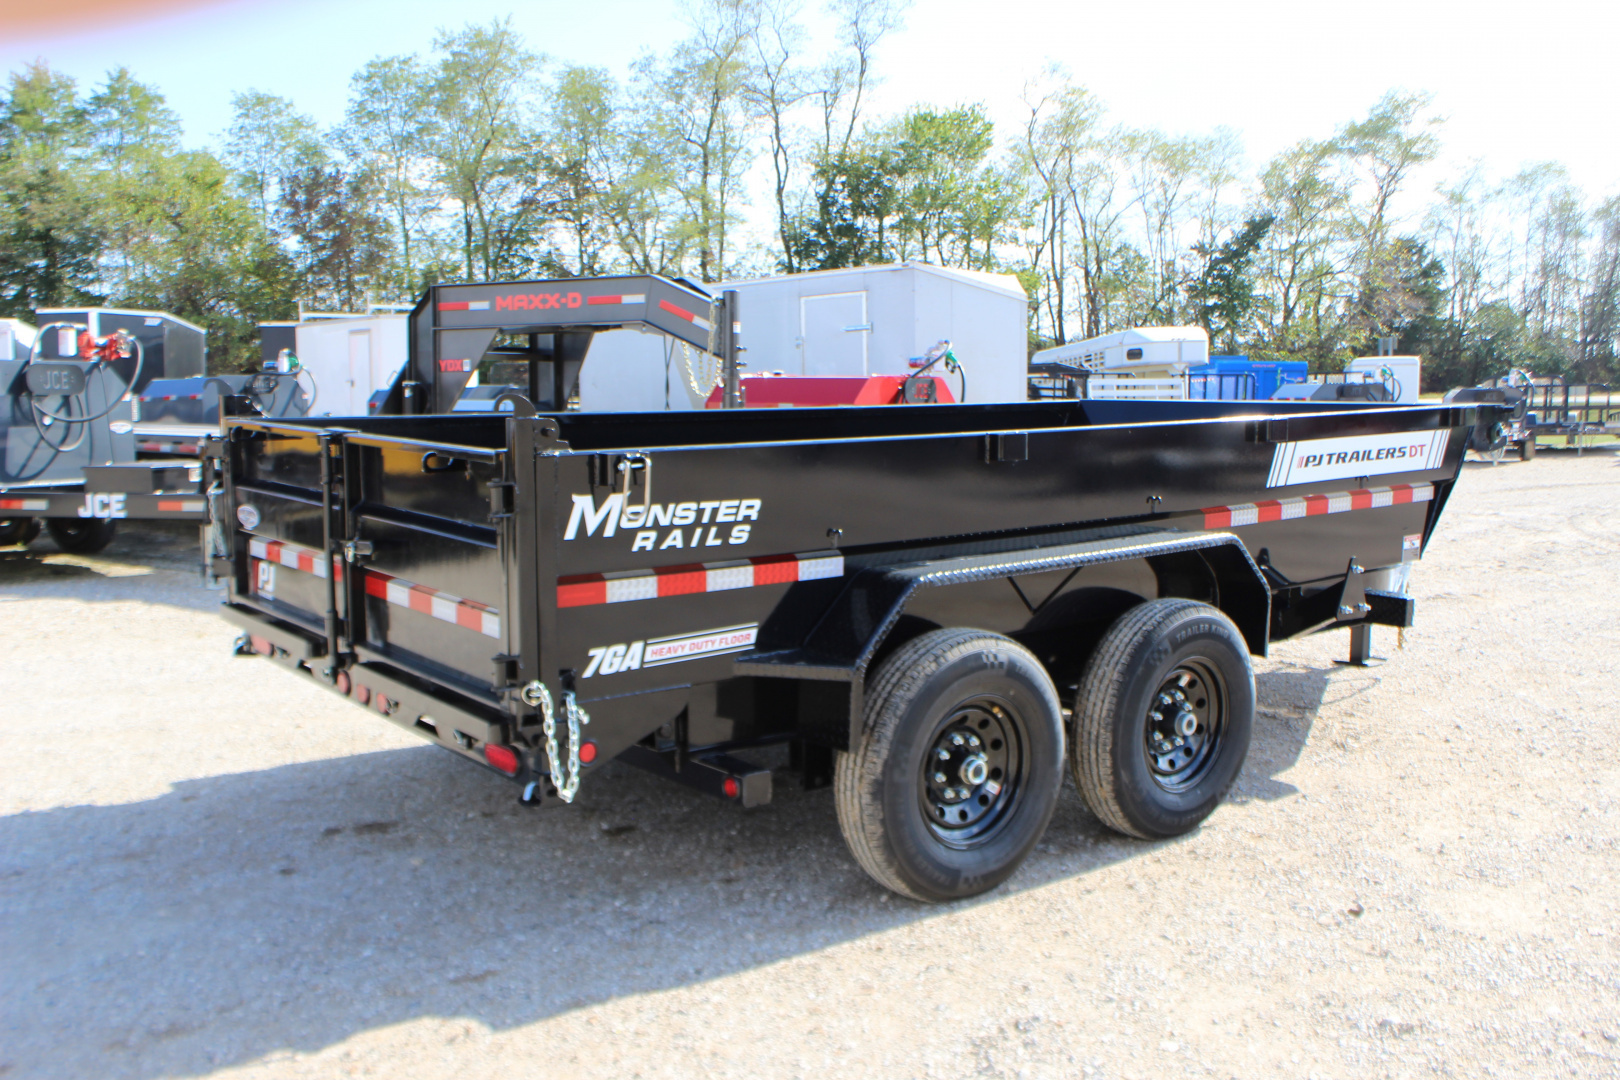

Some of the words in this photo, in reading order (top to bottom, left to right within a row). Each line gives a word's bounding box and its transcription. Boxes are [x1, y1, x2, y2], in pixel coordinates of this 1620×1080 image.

[495, 292, 582, 311] MAXX-D
[43, 371, 70, 390] JCE
[1409, 444, 1426, 458] DT
[77, 492, 128, 519] JCE
[563, 491, 762, 541] MONSTER
[631, 524, 751, 552] RAILS
[257, 560, 277, 593] PJ
[1176, 623, 1210, 642] TRAILER
[582, 640, 645, 679] 7GA
[650, 643, 686, 659] HEAVY
[688, 638, 716, 652] DUTY
[718, 633, 751, 647] FLOOR
